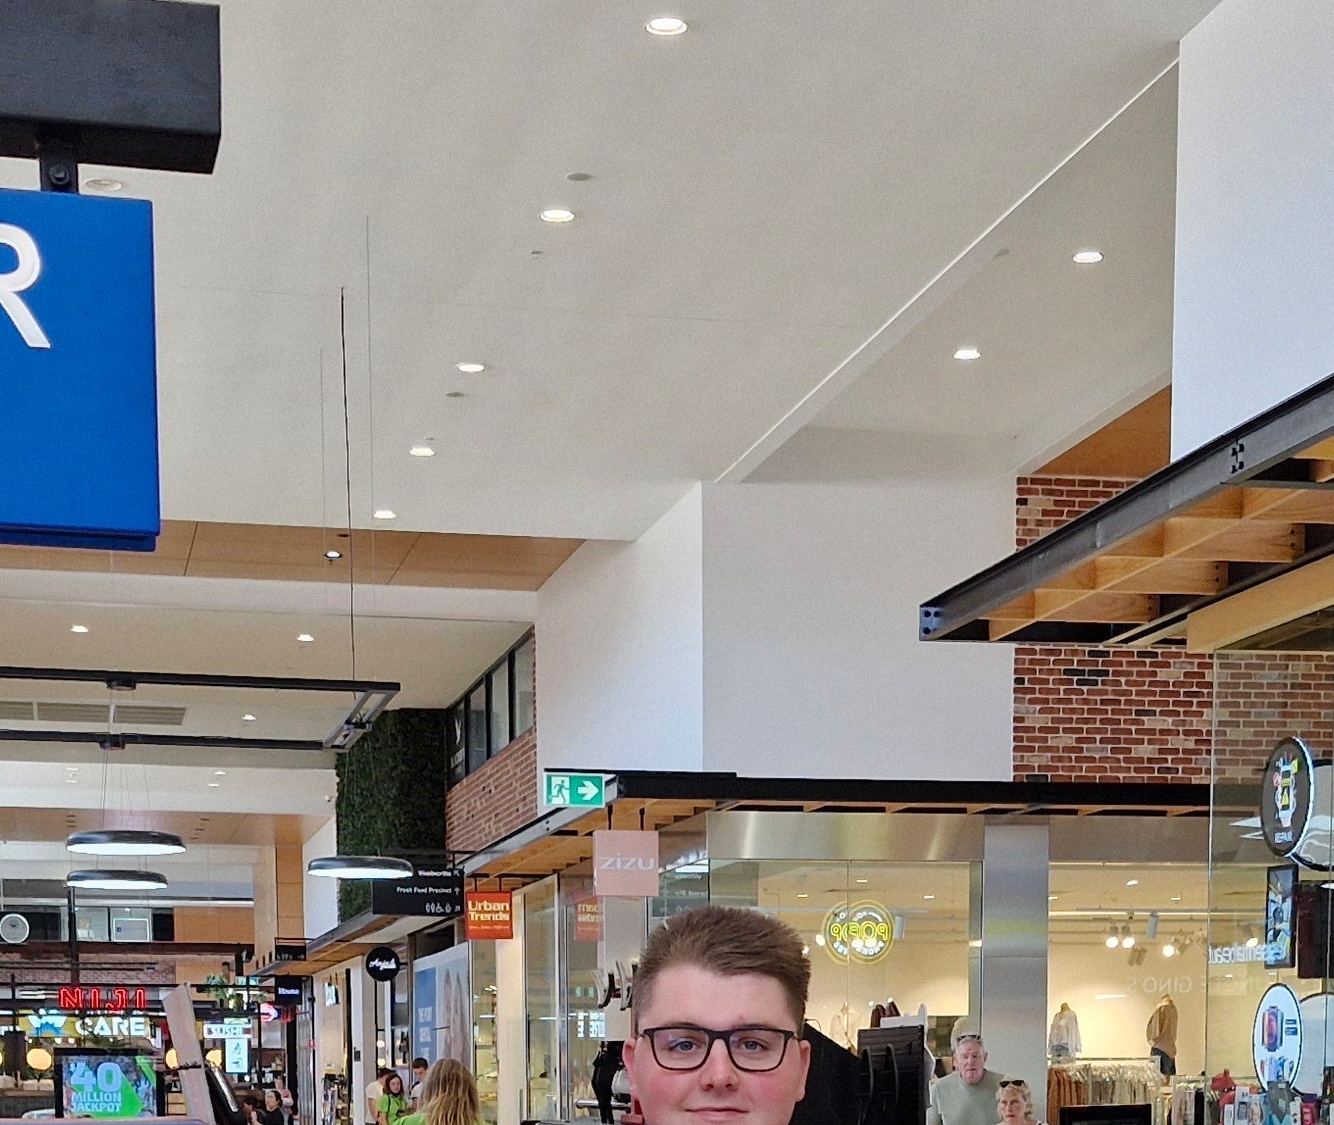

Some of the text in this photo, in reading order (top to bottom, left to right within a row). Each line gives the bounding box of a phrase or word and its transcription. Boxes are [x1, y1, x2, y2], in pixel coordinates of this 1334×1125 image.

[468, 900, 510, 911] Urban
[468, 911, 510, 922] Trends
[58, 986, 148, 1011] NIJI
[74, 1016, 146, 1036] CARE
[70, 1091, 122, 1102] MILLION
[70, 1102, 122, 1113] JACKPOT
